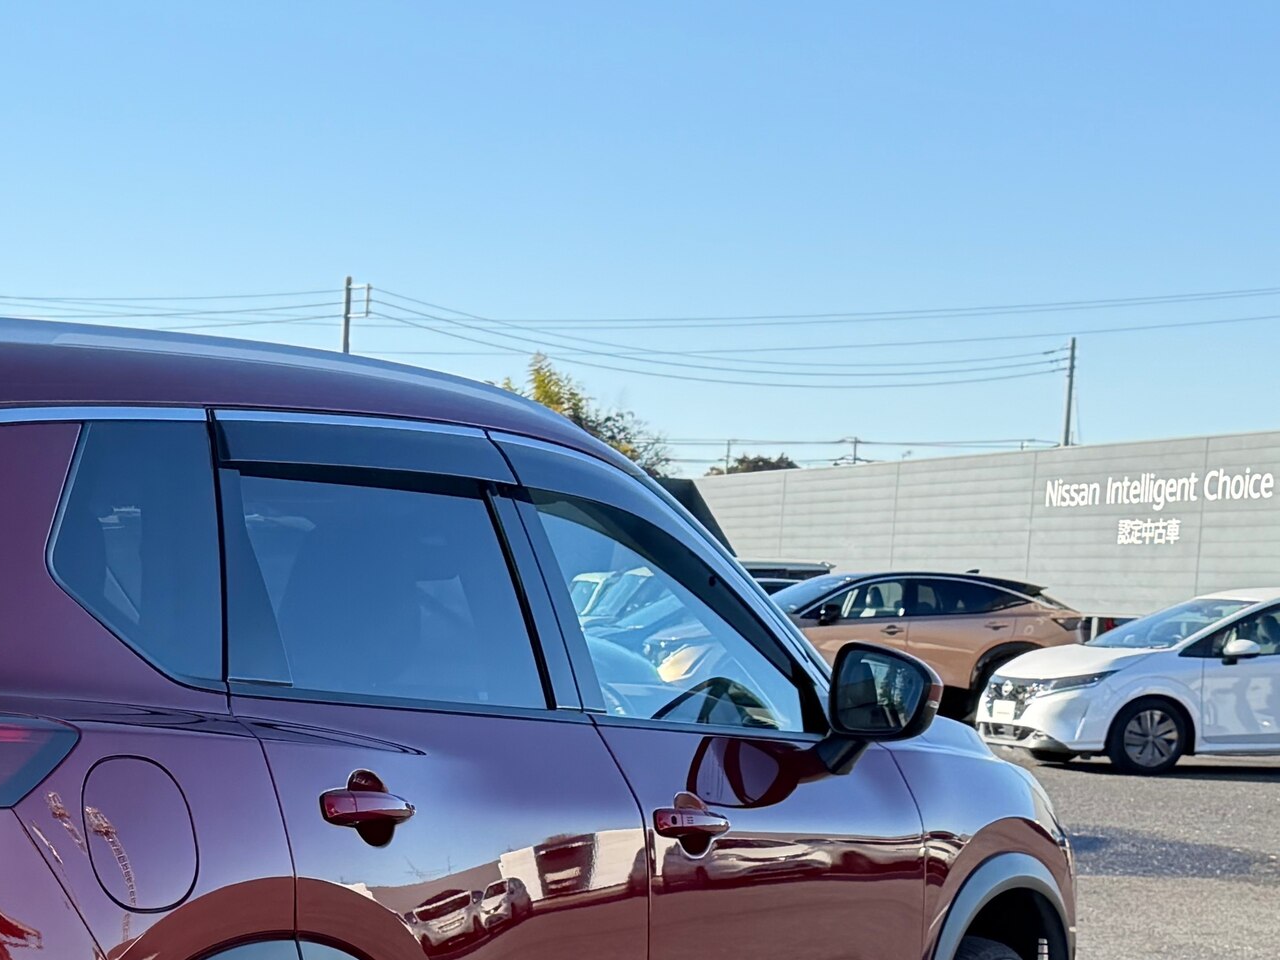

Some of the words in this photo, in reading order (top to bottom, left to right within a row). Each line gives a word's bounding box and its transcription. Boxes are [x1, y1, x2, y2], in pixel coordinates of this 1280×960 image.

[1045, 479, 1100, 507] Nissan
[1106, 472, 1200, 511] Intelligent
[1204, 467, 1274, 501] Choice
[1117, 518, 1181, 545] 認定中古車
